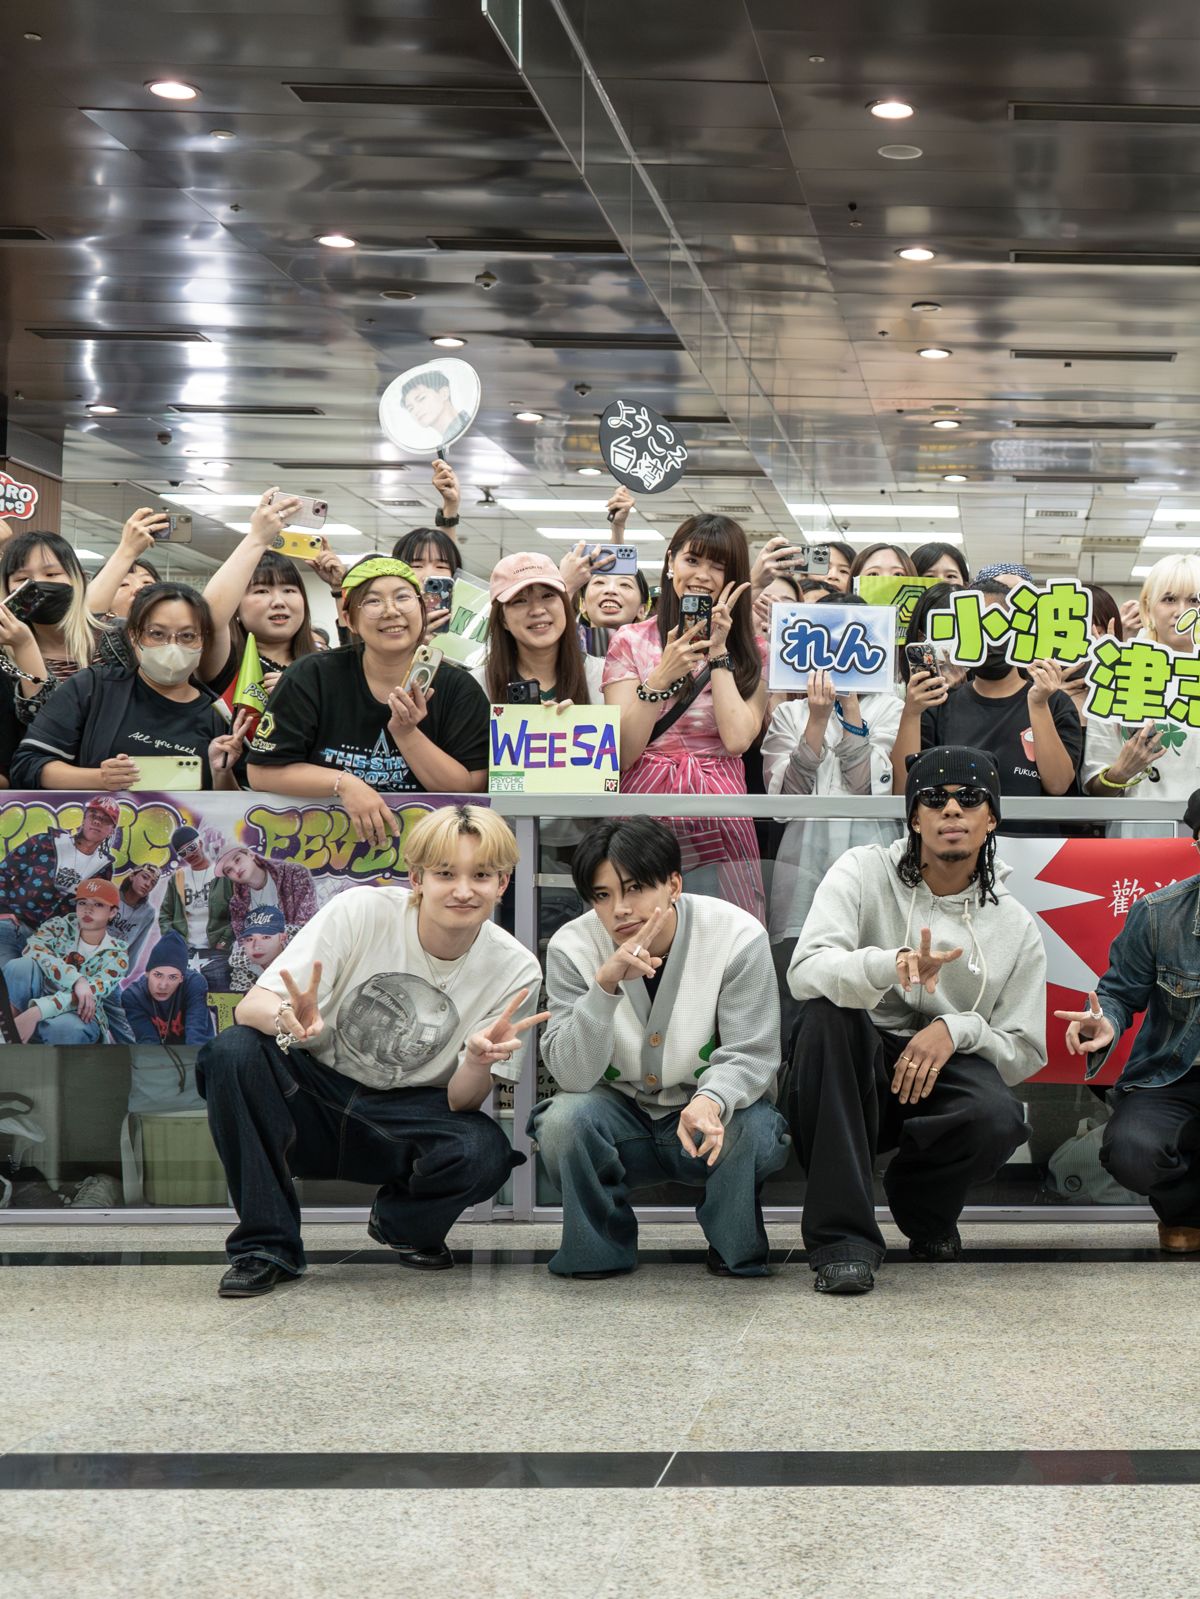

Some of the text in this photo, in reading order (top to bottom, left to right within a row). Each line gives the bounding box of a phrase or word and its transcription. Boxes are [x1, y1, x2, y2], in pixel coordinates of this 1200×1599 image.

[928, 580, 1091, 664] 小波
[780, 619, 887, 675] れん
[128, 731, 197, 756] All you need
[490, 719, 619, 771] WEESA
[490, 776, 524, 784] PSYCHIC
[1013, 766, 1041, 779] FUKUO
[490, 783, 524, 791] FEVER
